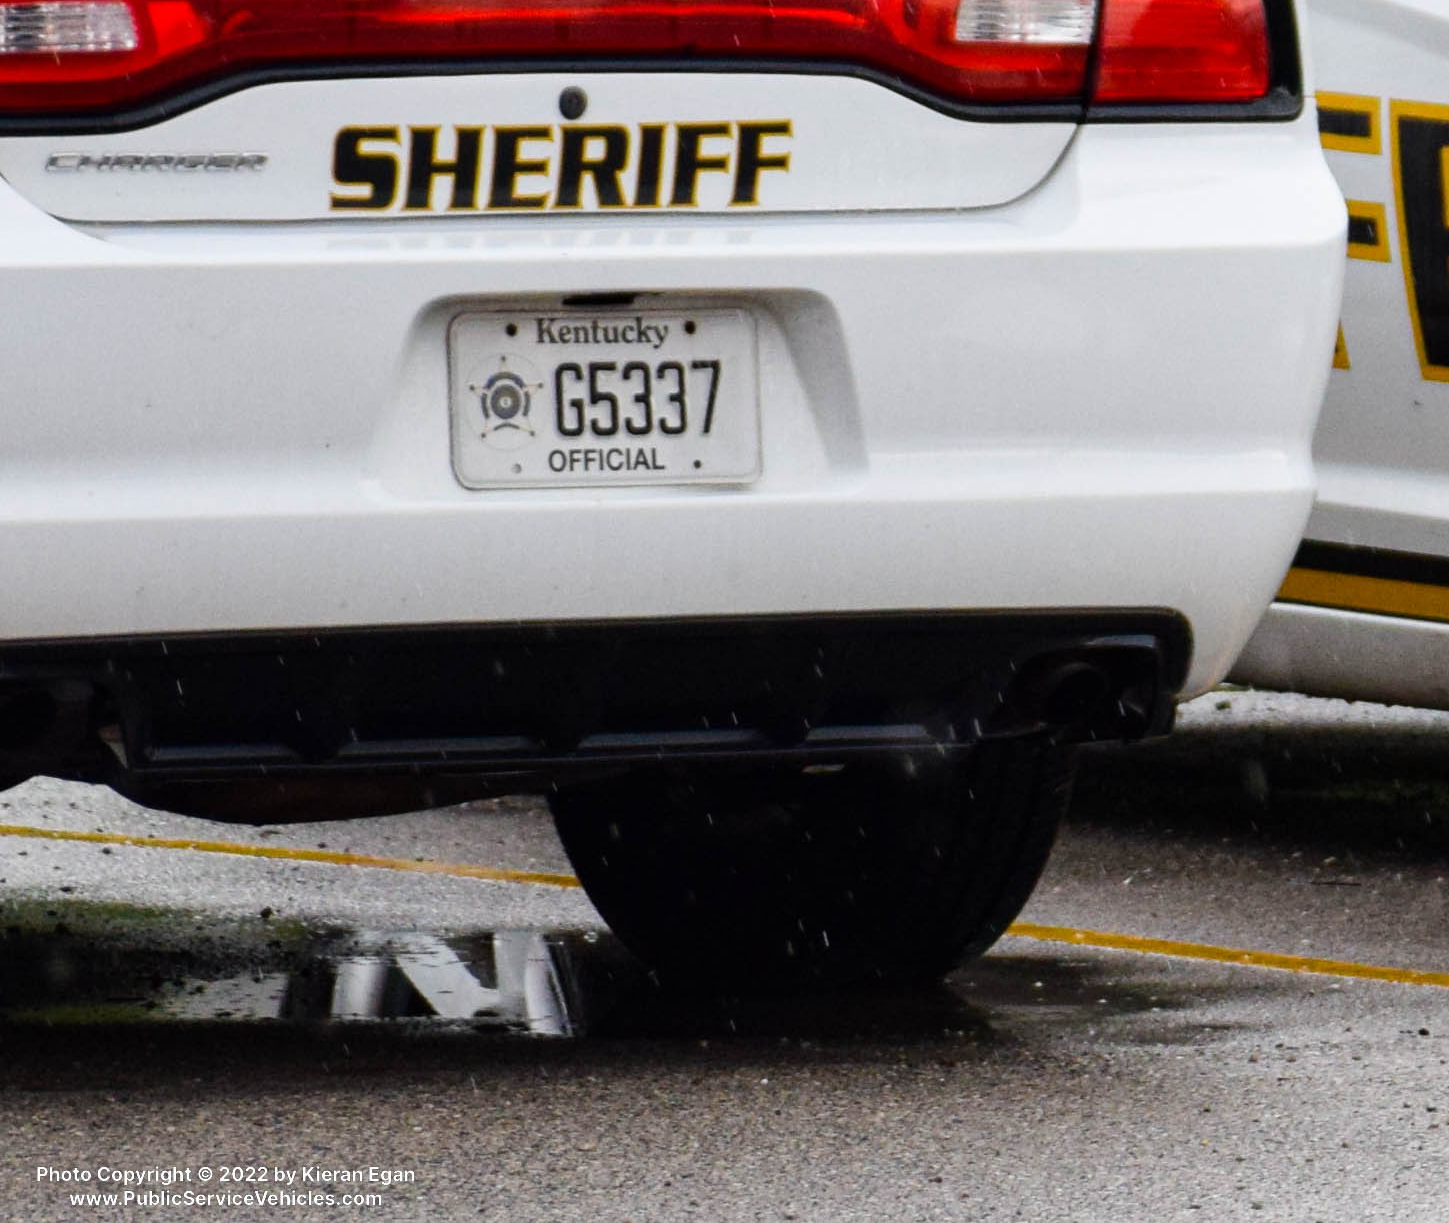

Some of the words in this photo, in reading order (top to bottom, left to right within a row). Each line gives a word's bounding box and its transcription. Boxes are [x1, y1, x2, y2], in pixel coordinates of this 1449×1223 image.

[46, 151, 269, 172] CHARGER
[330, 119, 793, 212] SHERIFF
[534, 317, 669, 349] Kentucky
[554, 359, 721, 437] G5337
[548, 447, 666, 472] OFFICIAL
